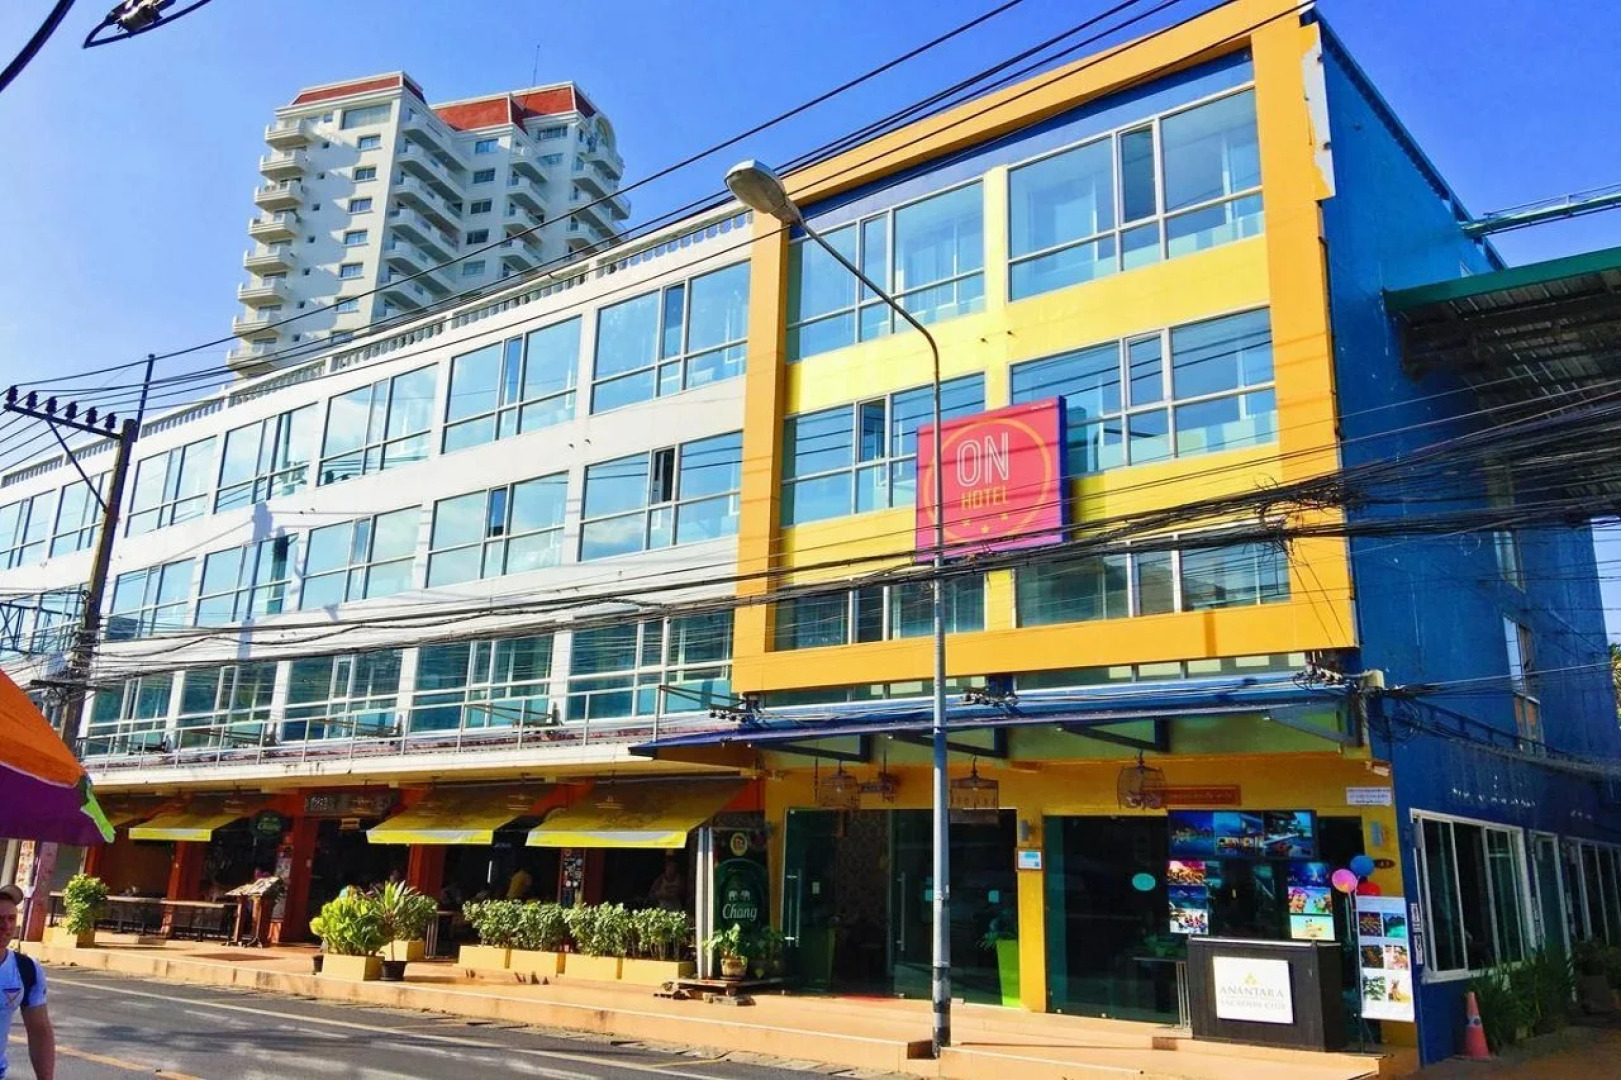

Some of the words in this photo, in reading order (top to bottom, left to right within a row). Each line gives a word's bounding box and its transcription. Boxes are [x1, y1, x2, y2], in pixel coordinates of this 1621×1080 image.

[957, 431, 1009, 487] ON
[961, 485, 1008, 510] HOTEL
[722, 903, 758, 922] Chang
[1220, 985, 1285, 998] ANANTARA
